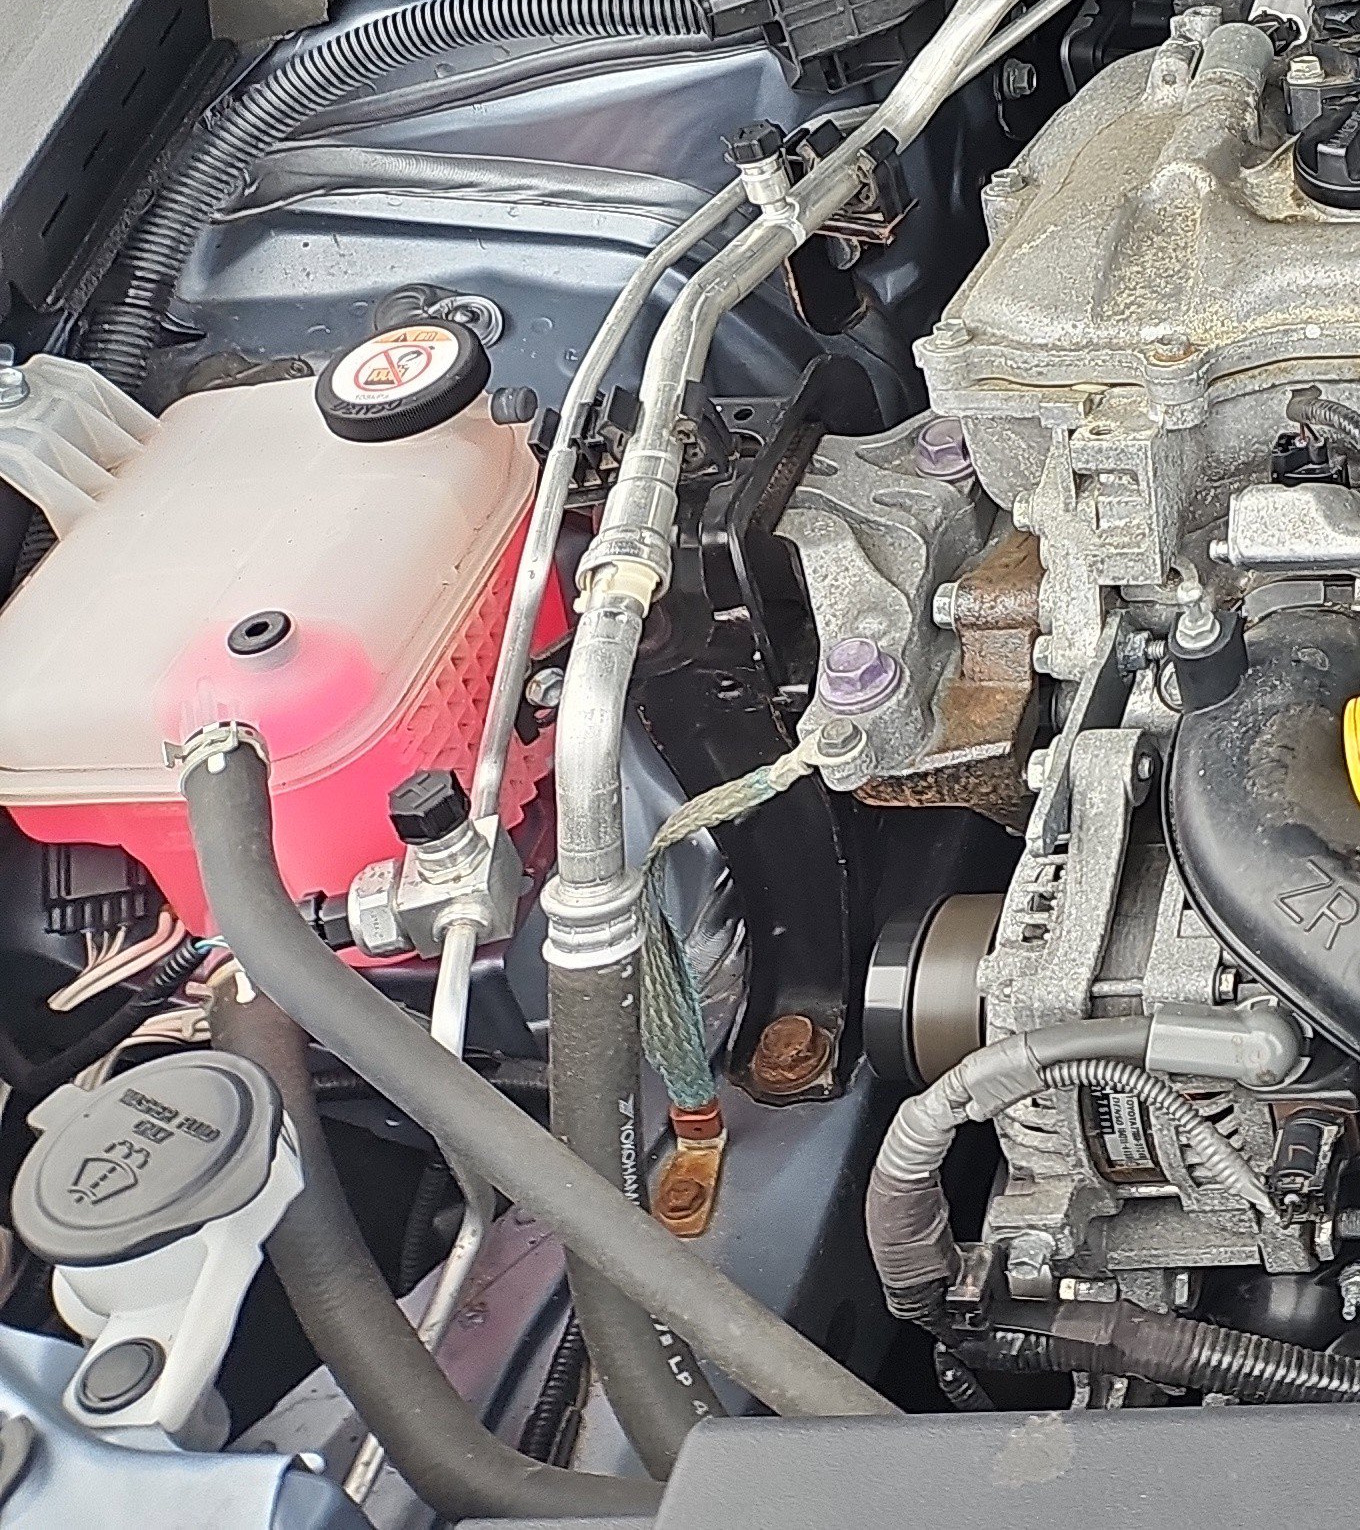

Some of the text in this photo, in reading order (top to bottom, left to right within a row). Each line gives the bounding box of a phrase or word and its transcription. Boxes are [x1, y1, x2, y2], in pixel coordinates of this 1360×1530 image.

[1274, 858, 1360, 951] ZR
[1112, 1096, 1125, 1127] DENSO
[1125, 1094, 1138, 1127] TOYOTA
[619, 1119, 640, 1207] YOKOHAM
[667, 1355, 693, 1387] LP
